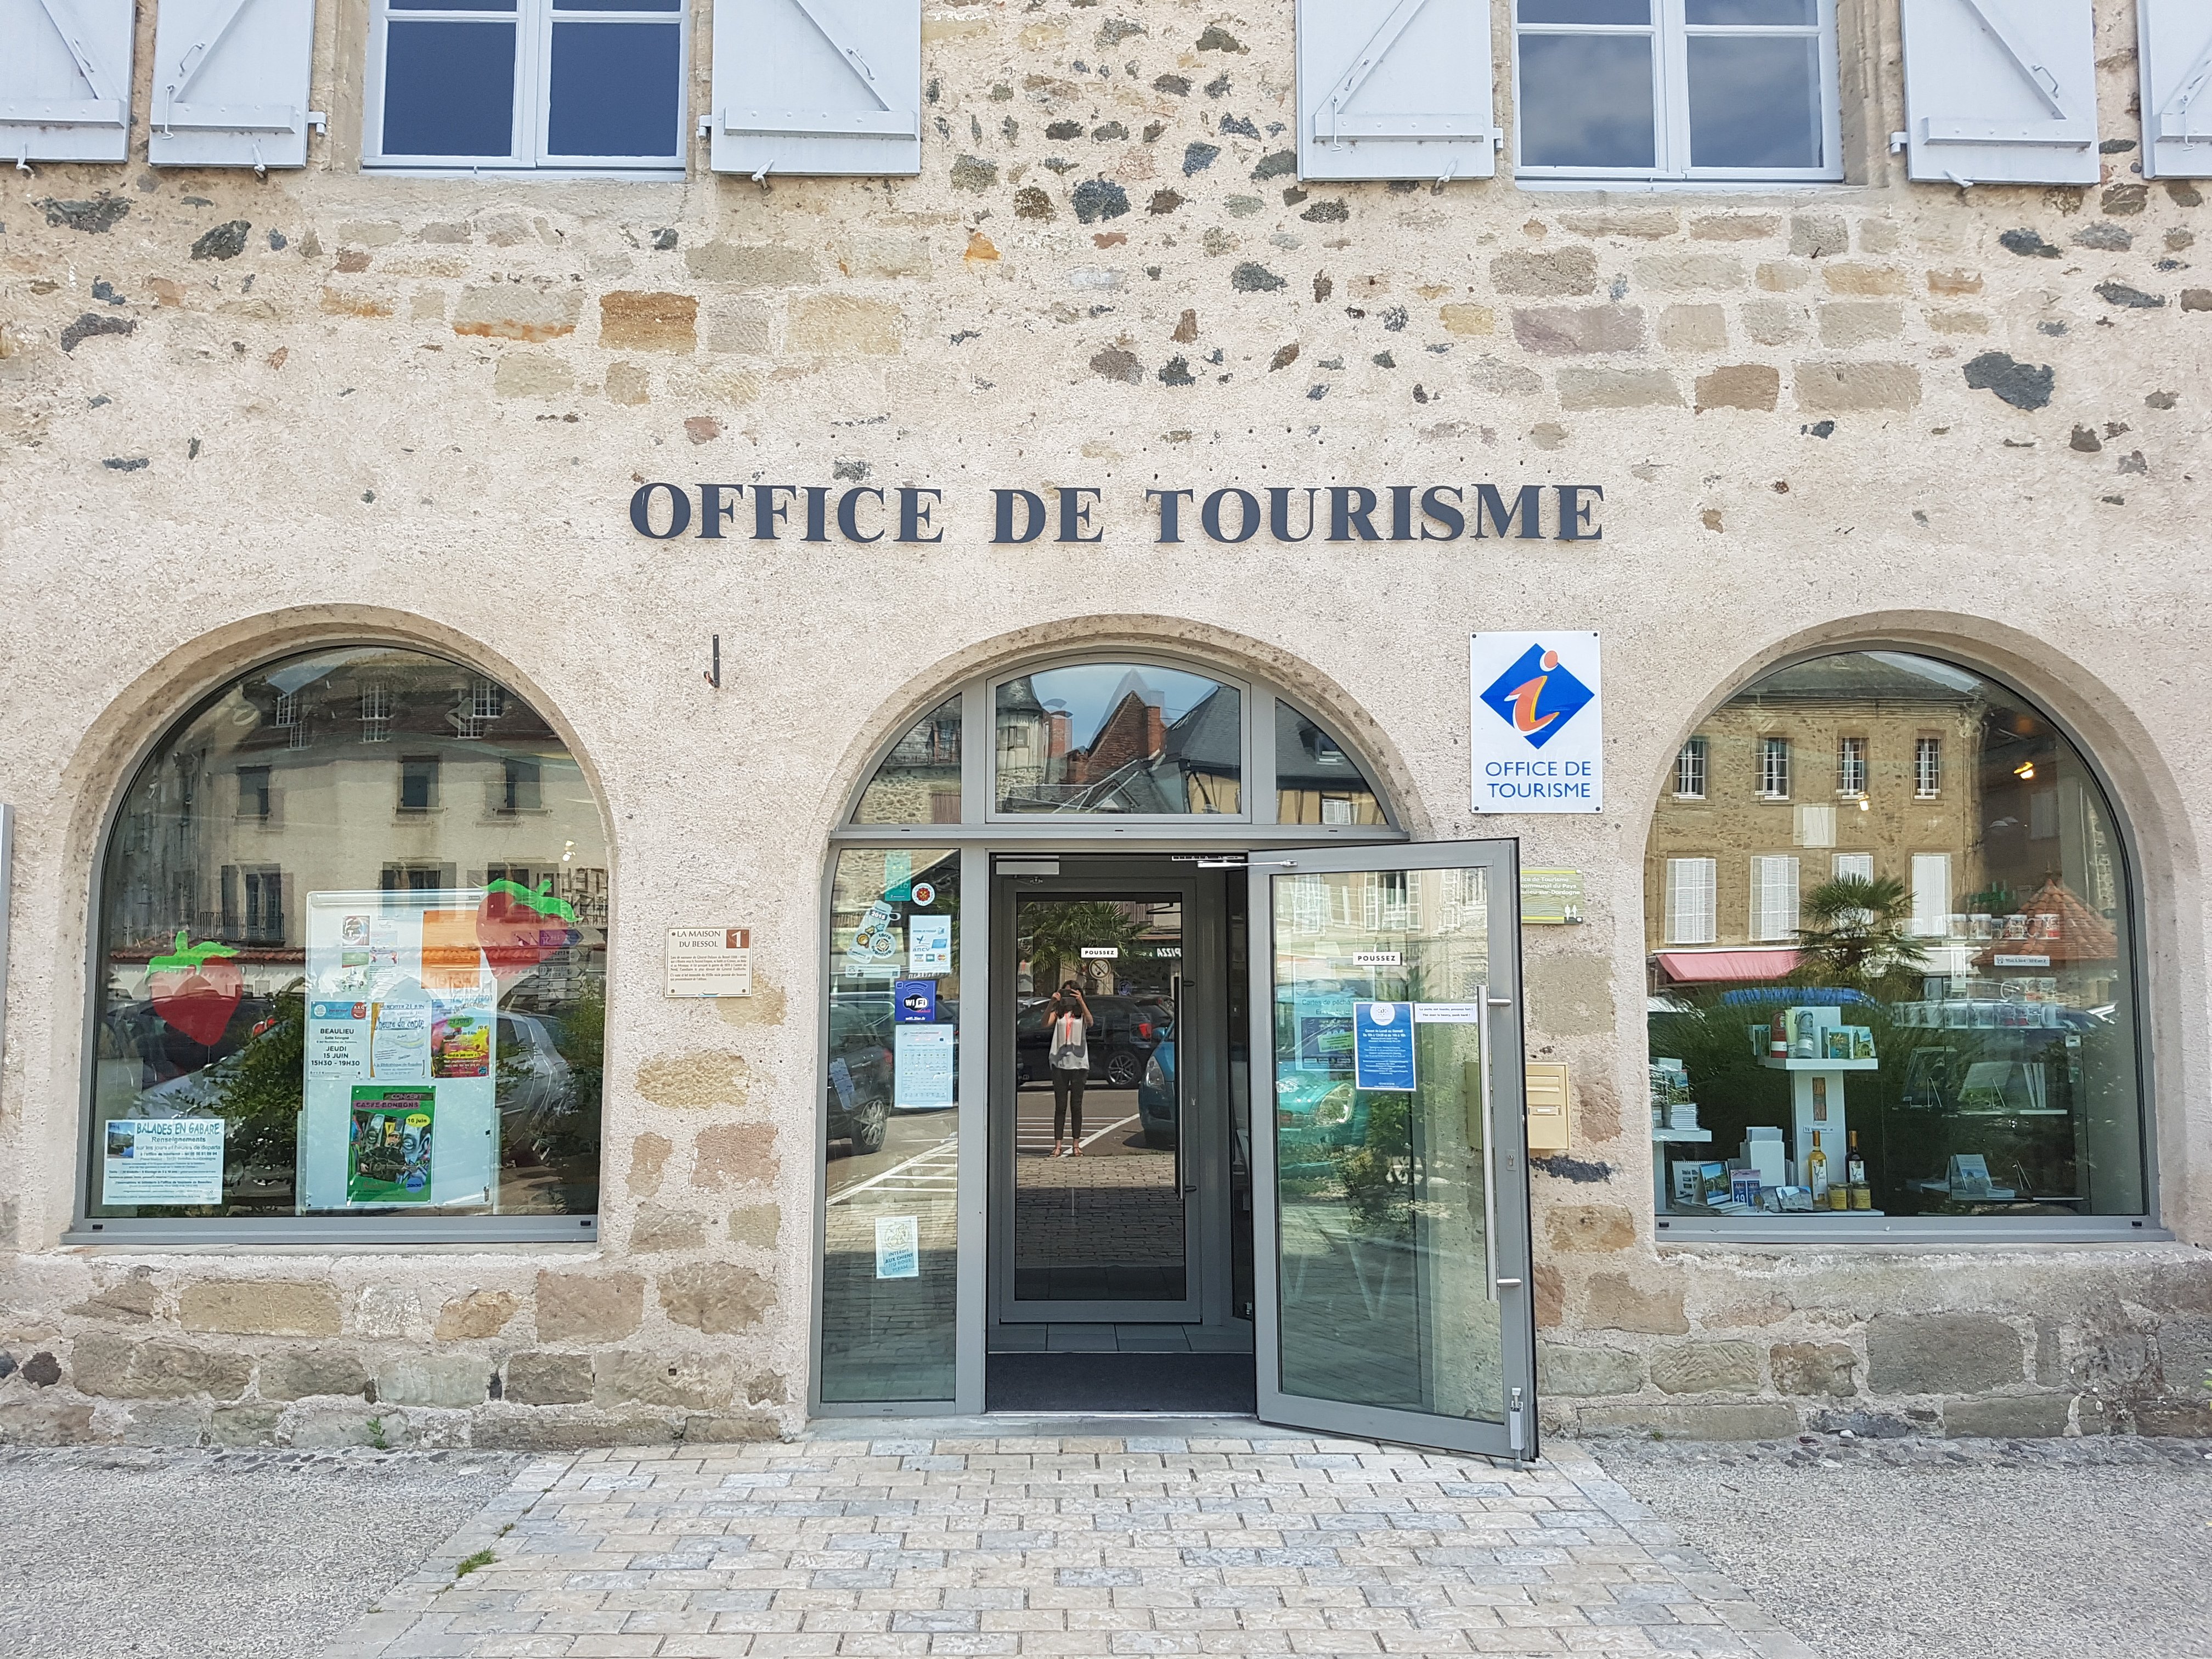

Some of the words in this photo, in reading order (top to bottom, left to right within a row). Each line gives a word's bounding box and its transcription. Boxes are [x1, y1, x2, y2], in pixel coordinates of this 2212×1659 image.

[629, 482, 945, 543] OFFICE
[988, 487, 1104, 543] DE
[1146, 483, 1604, 544] TOURISME
[1485, 761, 1558, 777] OFFICE
[1565, 761, 1592, 776] DE
[1486, 782, 1591, 798] TOURISME
[871, 911, 885, 919] 2015
[731, 930, 741, 947] 1
[398, 1017, 405, 1028] du
[137, 1122, 172, 1135] BALADES
[175, 1121, 187, 1135] EN
[188, 1122, 220, 1135] GABARE
[1735, 1194, 1745, 1203] 19
[888, 1248, 909, 1257] INTERDIT
